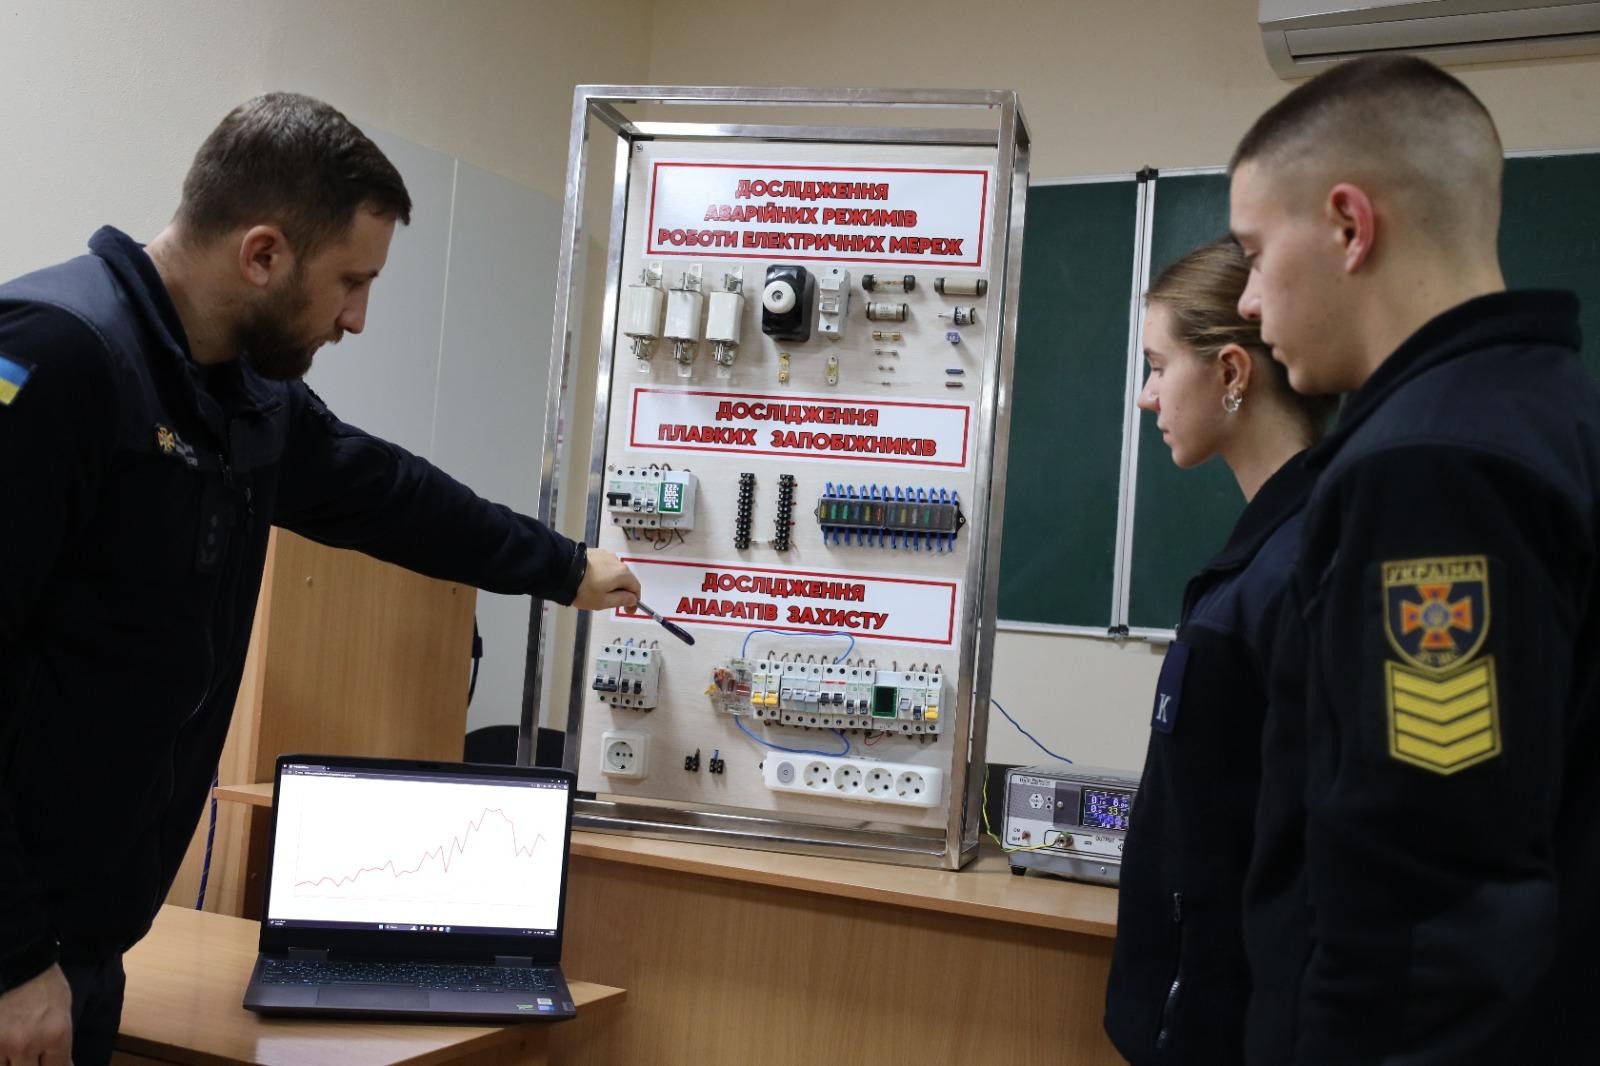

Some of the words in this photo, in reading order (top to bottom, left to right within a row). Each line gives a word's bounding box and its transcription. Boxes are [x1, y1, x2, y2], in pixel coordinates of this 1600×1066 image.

[735, 179, 889, 201] ДОСЛІДЖЕННЯ
[704, 202, 818, 225] АВАРІЙНИХ
[822, 207, 918, 228] РЕЖИМІВ
[657, 228, 738, 248] РОБОТИ
[742, 231, 886, 254] ЕЛЕКТРИЧНИХ
[889, 235, 964, 256] МЕРЕЖ
[716, 401, 879, 427] ДОСЛІДЖЕННЯ
[658, 424, 758, 446] ПЛАВКИХ
[770, 430, 937, 457] ЗАПОБІЖНИКІВ
[702, 572, 866, 602] ДОСЛІДЖЕННЯ
[676, 596, 778, 622] АПАРАТІВ
[786, 605, 889, 631] ЗАХИСТУ
